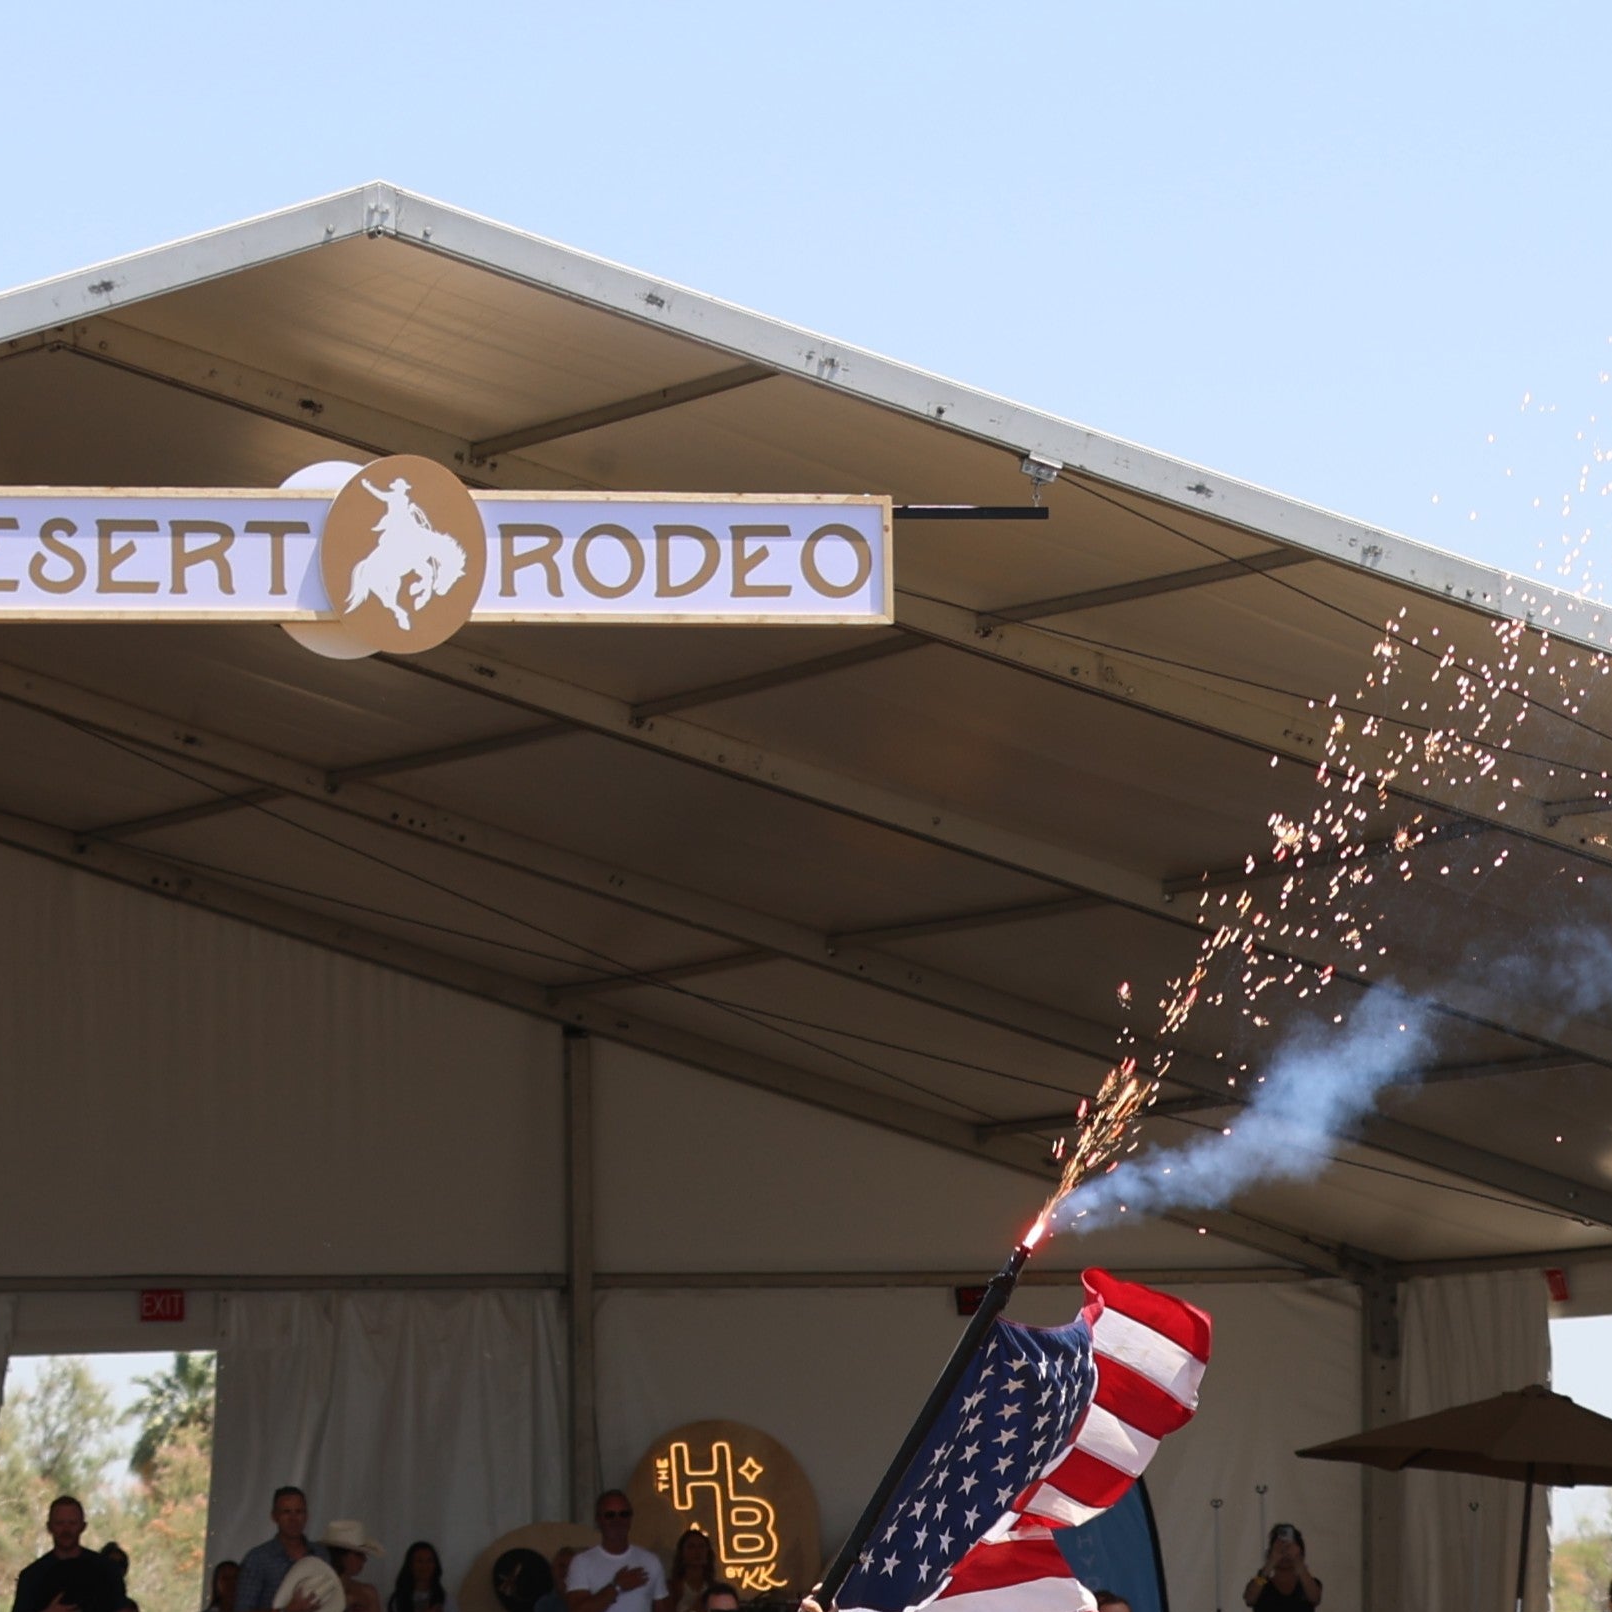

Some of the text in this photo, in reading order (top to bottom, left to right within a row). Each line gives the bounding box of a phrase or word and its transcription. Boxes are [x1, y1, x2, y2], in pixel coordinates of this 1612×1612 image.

[498, 520, 873, 600] RODEO
[141, 1293, 183, 1318] EXIT
[655, 1457, 670, 1493] THE
[725, 1562, 790, 1592] BY KK
